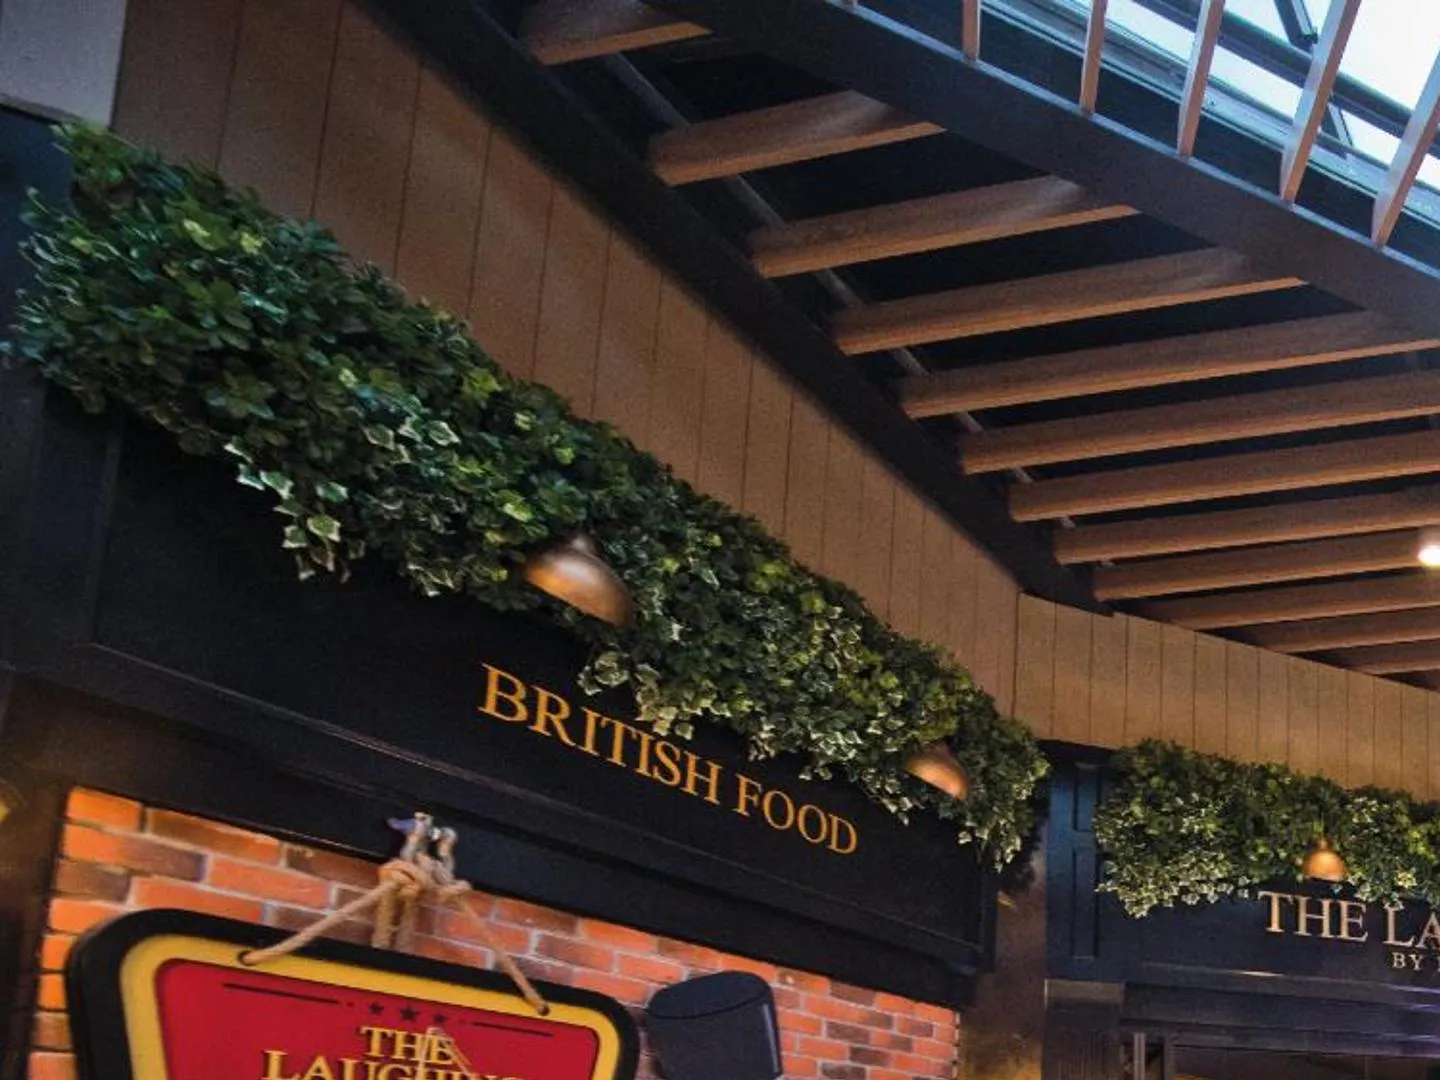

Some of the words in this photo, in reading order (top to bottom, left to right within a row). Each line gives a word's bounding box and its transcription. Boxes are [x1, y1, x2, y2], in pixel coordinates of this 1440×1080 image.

[478, 662, 723, 805] BRITISH
[733, 773, 858, 854] FOOD
[1257, 890, 1369, 942] THE
[1391, 951, 1424, 972] BY
[359, 1025, 455, 1065] THE
